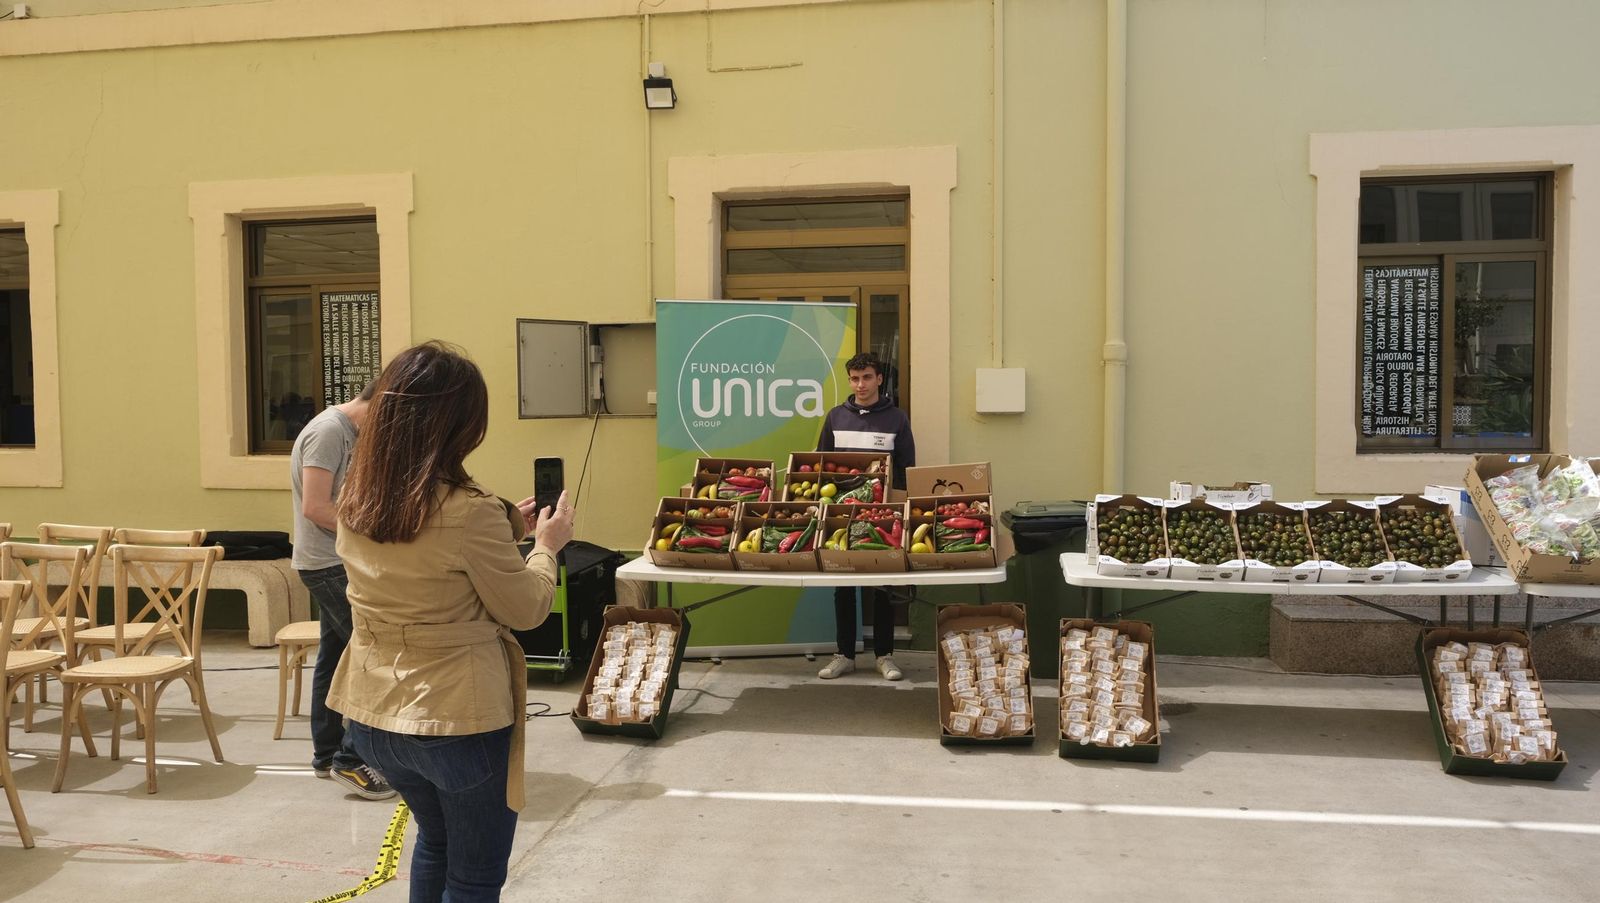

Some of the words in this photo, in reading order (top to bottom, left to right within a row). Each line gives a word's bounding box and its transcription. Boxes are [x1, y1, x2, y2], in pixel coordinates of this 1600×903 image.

[323, 324, 330, 332] DE
[372, 340, 380, 368] CULTURA
[691, 362, 775, 374] FUNDACIÓN
